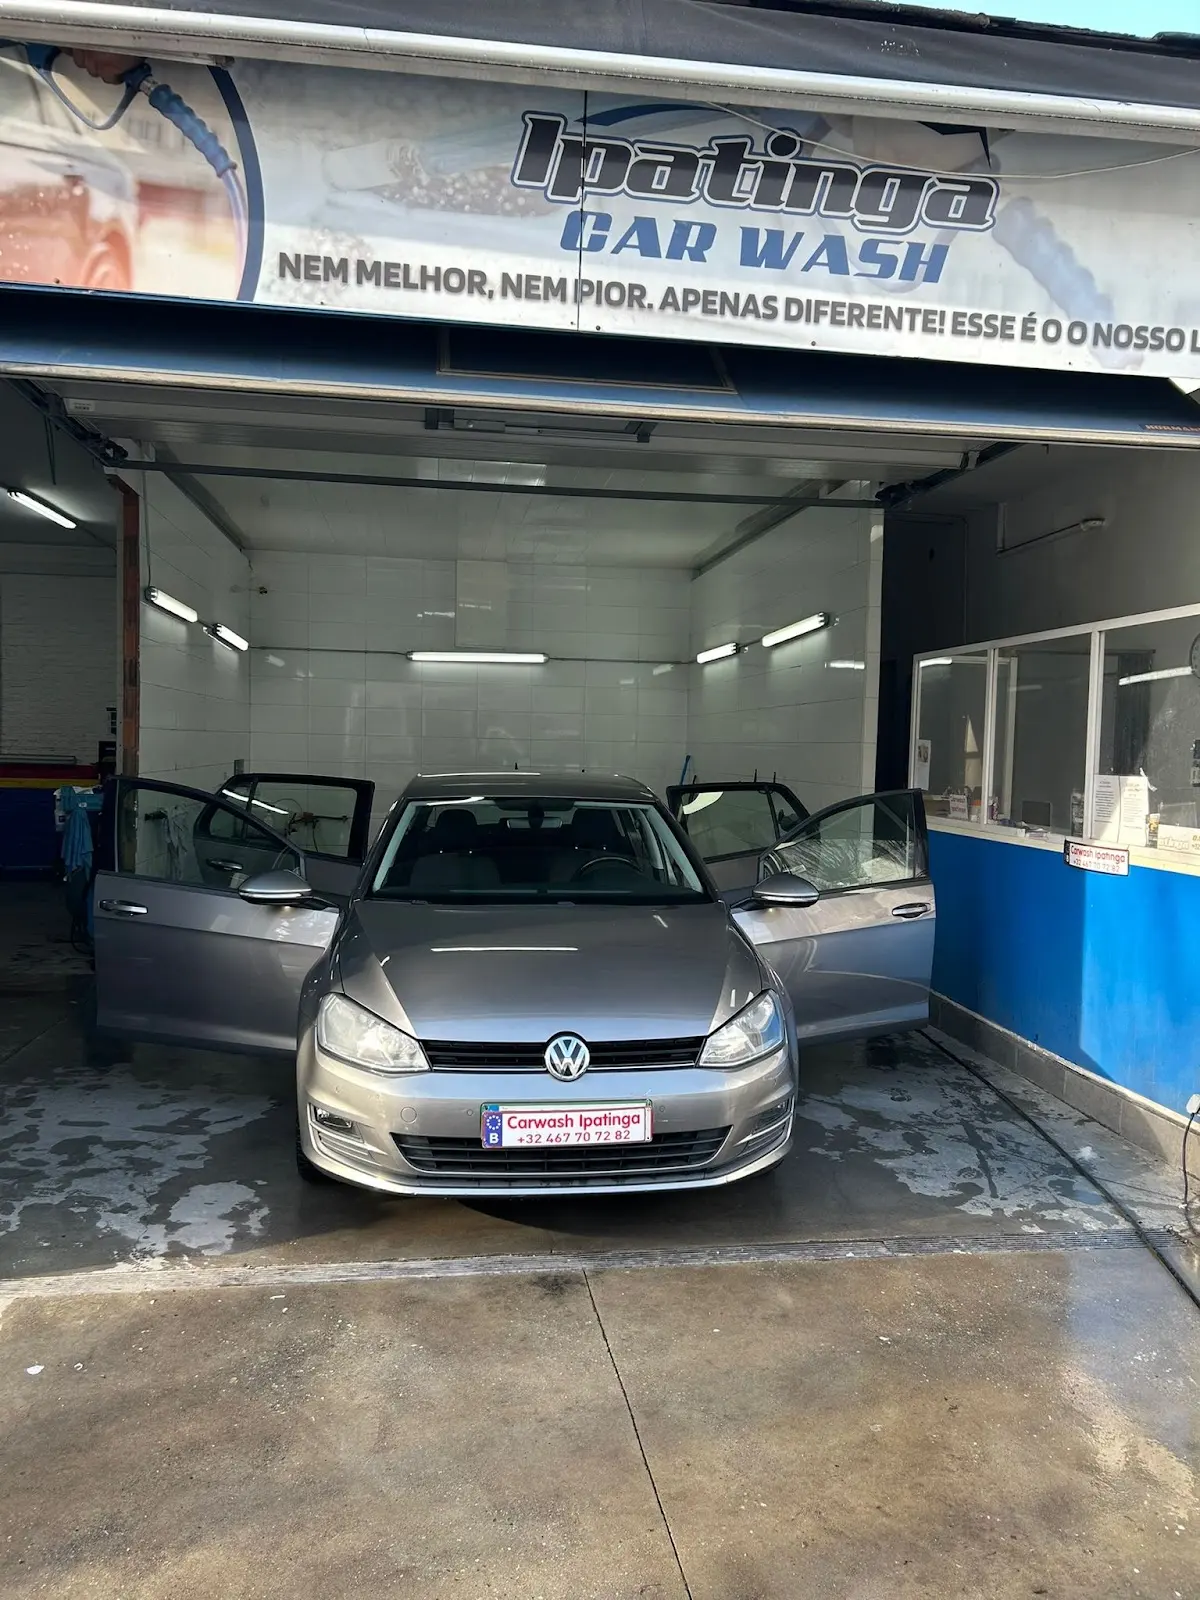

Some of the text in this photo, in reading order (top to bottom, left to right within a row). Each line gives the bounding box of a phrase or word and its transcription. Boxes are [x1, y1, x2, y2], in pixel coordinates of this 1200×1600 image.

[511, 110, 1000, 235] Ipatinga
[560, 210, 950, 283] CAR WASH
[278, 252, 348, 283] NEM
[356, 259, 494, 298] MELHOR,
[501, 272, 566, 302] NEM
[574, 278, 653, 309] PIOR.
[660, 287, 778, 320] APENAS
[785, 297, 945, 334] DIFERENTE!
[951, 311, 1016, 340] ESSE
[1021, 312, 1037, 341] É
[1042, 319, 1062, 343] O
[1067, 321, 1087, 345] O
[1093, 322, 1185, 352] NOSSO
[1071, 845, 1126, 865] Carwash Ipatinga
[507, 1112, 640, 1130] Carwash Ipatinga
[489, 1132, 499, 1144] B
[517, 1130, 630, 1144] +32 467 70 72 82
